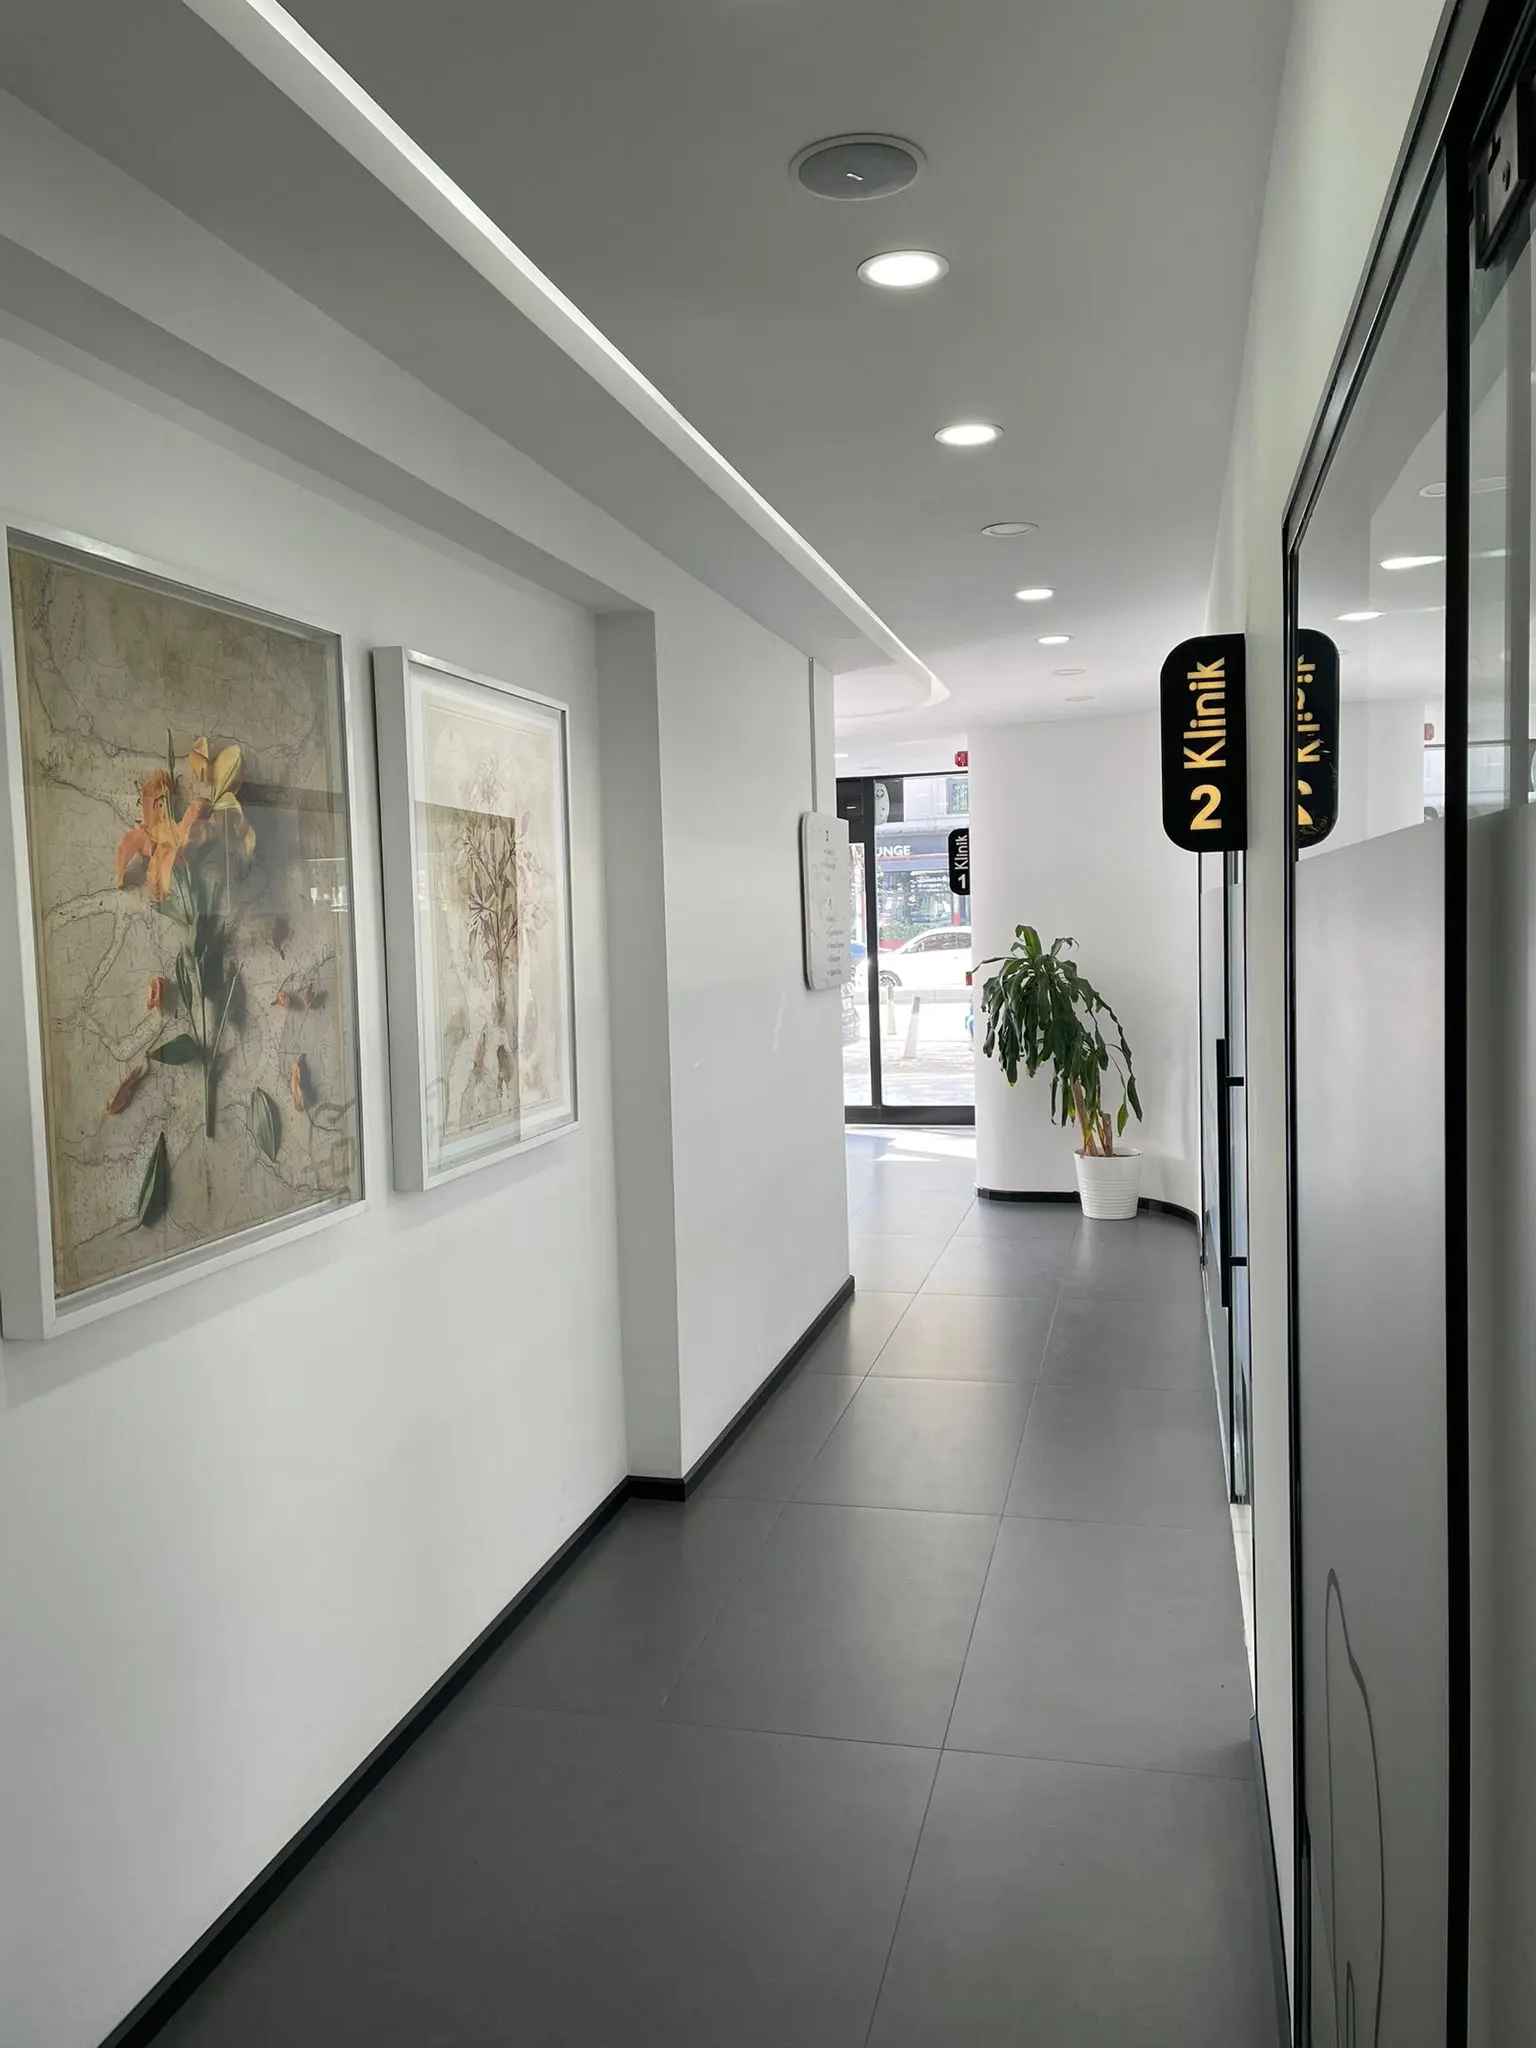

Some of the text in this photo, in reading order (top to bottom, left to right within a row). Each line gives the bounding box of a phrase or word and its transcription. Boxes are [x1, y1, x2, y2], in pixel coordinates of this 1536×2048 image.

[1183, 656, 1227, 831] 2 Klinik
[954, 834, 969, 889] 1 Klinik
